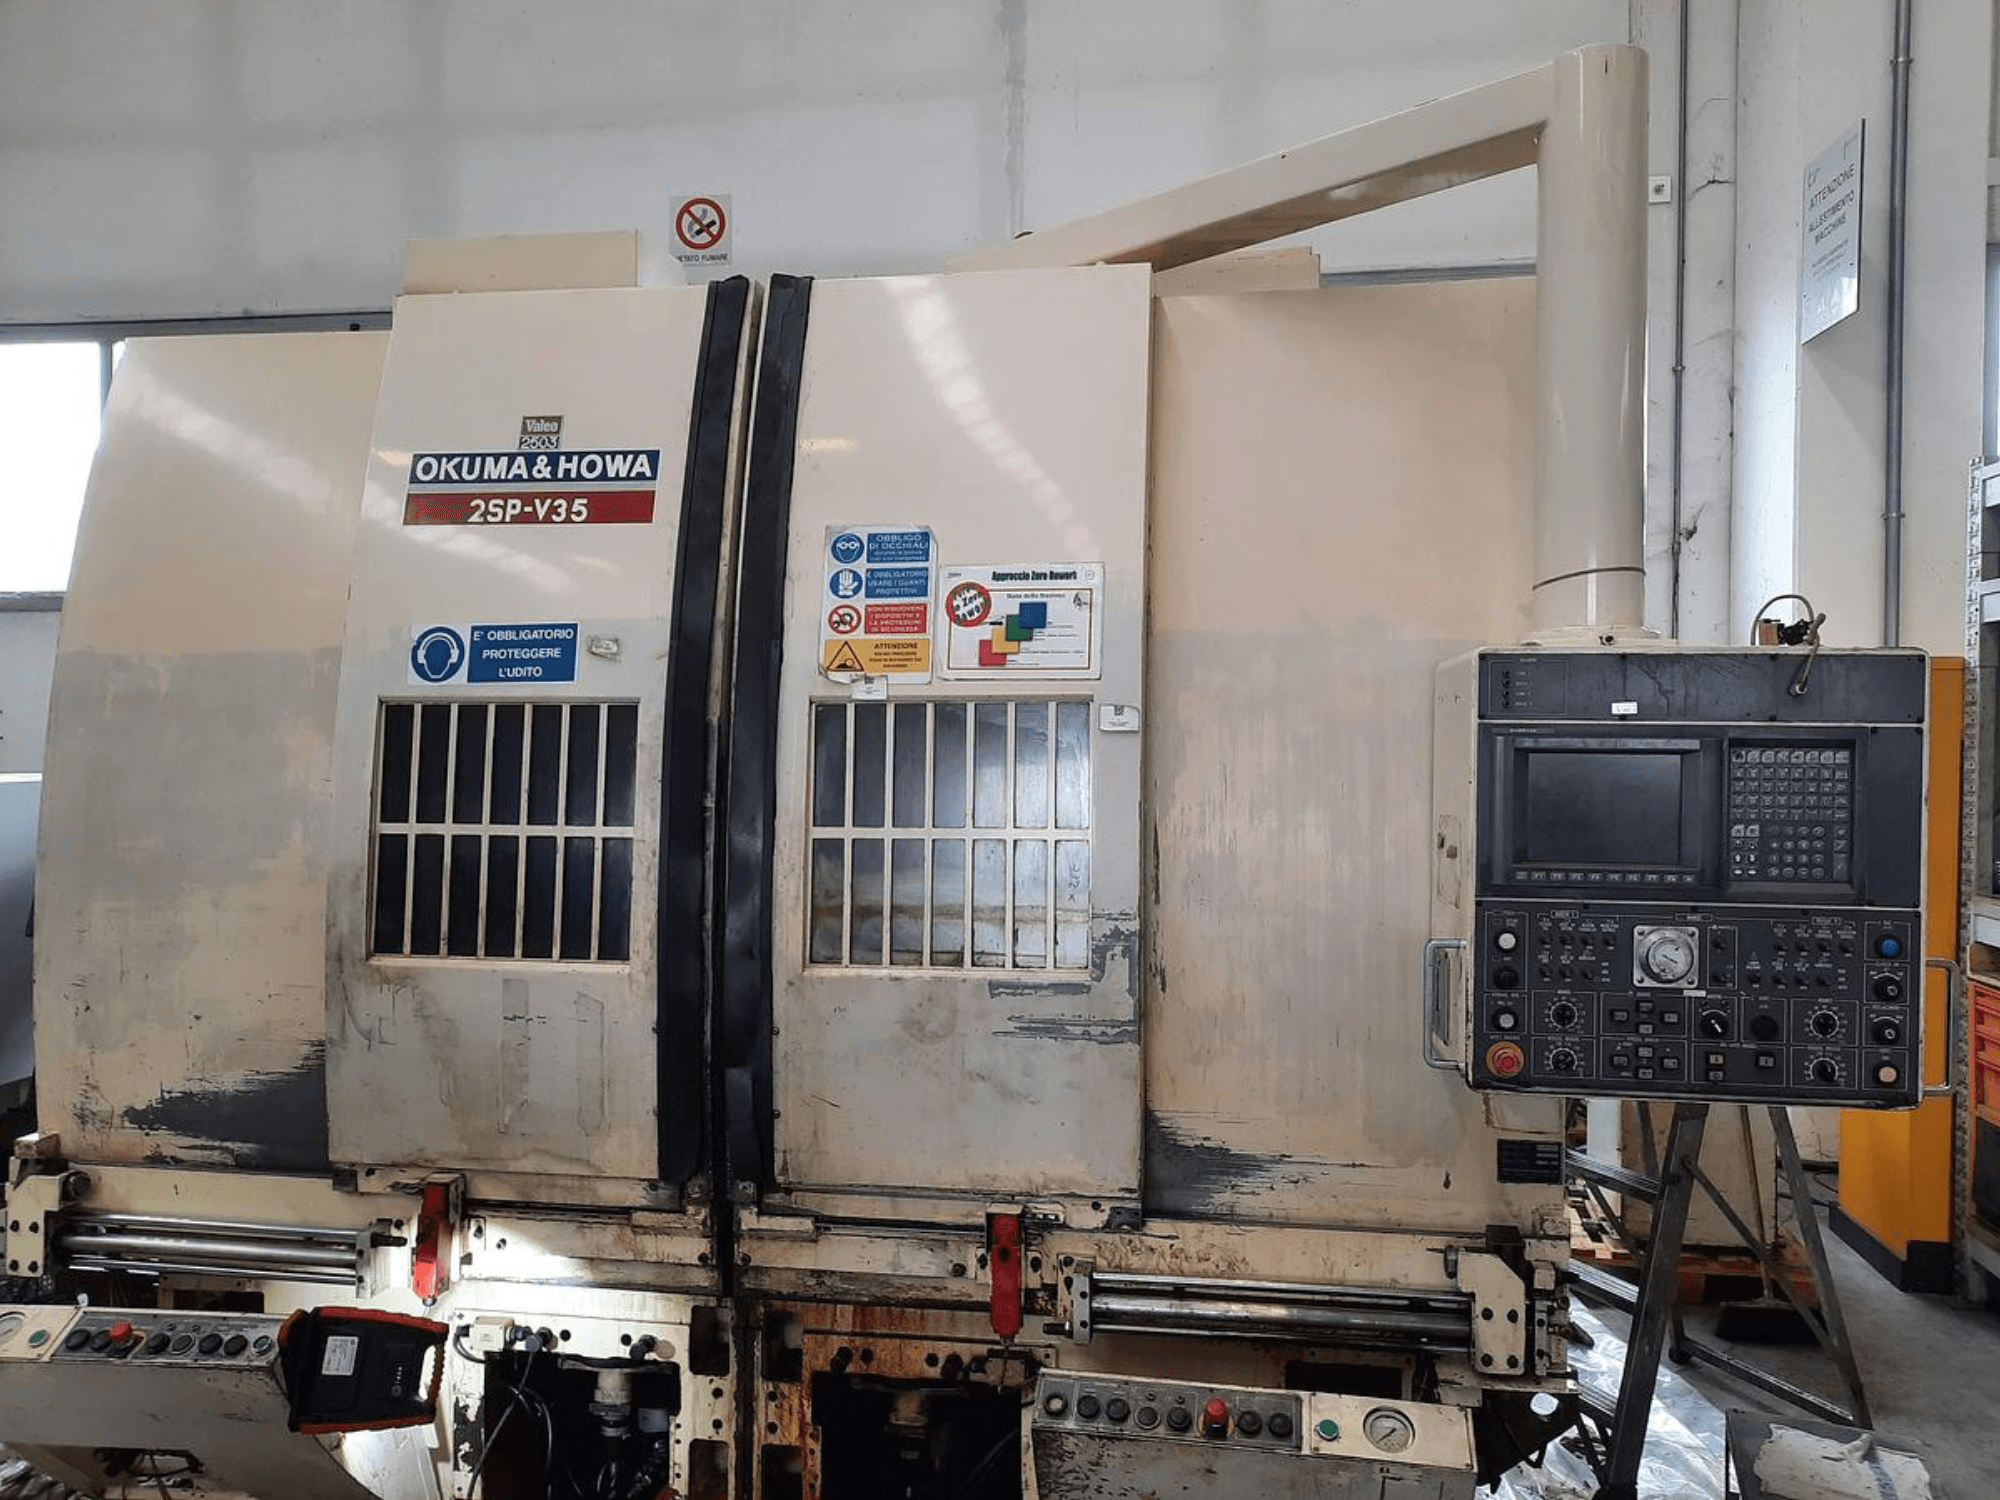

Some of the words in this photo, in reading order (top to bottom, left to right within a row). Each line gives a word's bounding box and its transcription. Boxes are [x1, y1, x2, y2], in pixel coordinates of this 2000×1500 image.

[1808, 162, 1854, 211] ATTENZIONE
[1808, 189, 1854, 233] ALLESTIMENTO
[525, 418, 559, 433] Valeo
[467, 497, 588, 523] 2SP-V35
[875, 534, 922, 543] OBBLIGO
[881, 542, 929, 550] OCCHIALI
[991, 570, 1030, 581] Approccio
[1031, 571, 1048, 580] Zero
[1049, 570, 1078, 580] Rework
[487, 628, 574, 641] OBBLIGATORIO
[874, 642, 918, 650] ATTENZIONE
[482, 647, 562, 660] PROTEGGERE
[498, 666, 543, 679] L'UDITO
